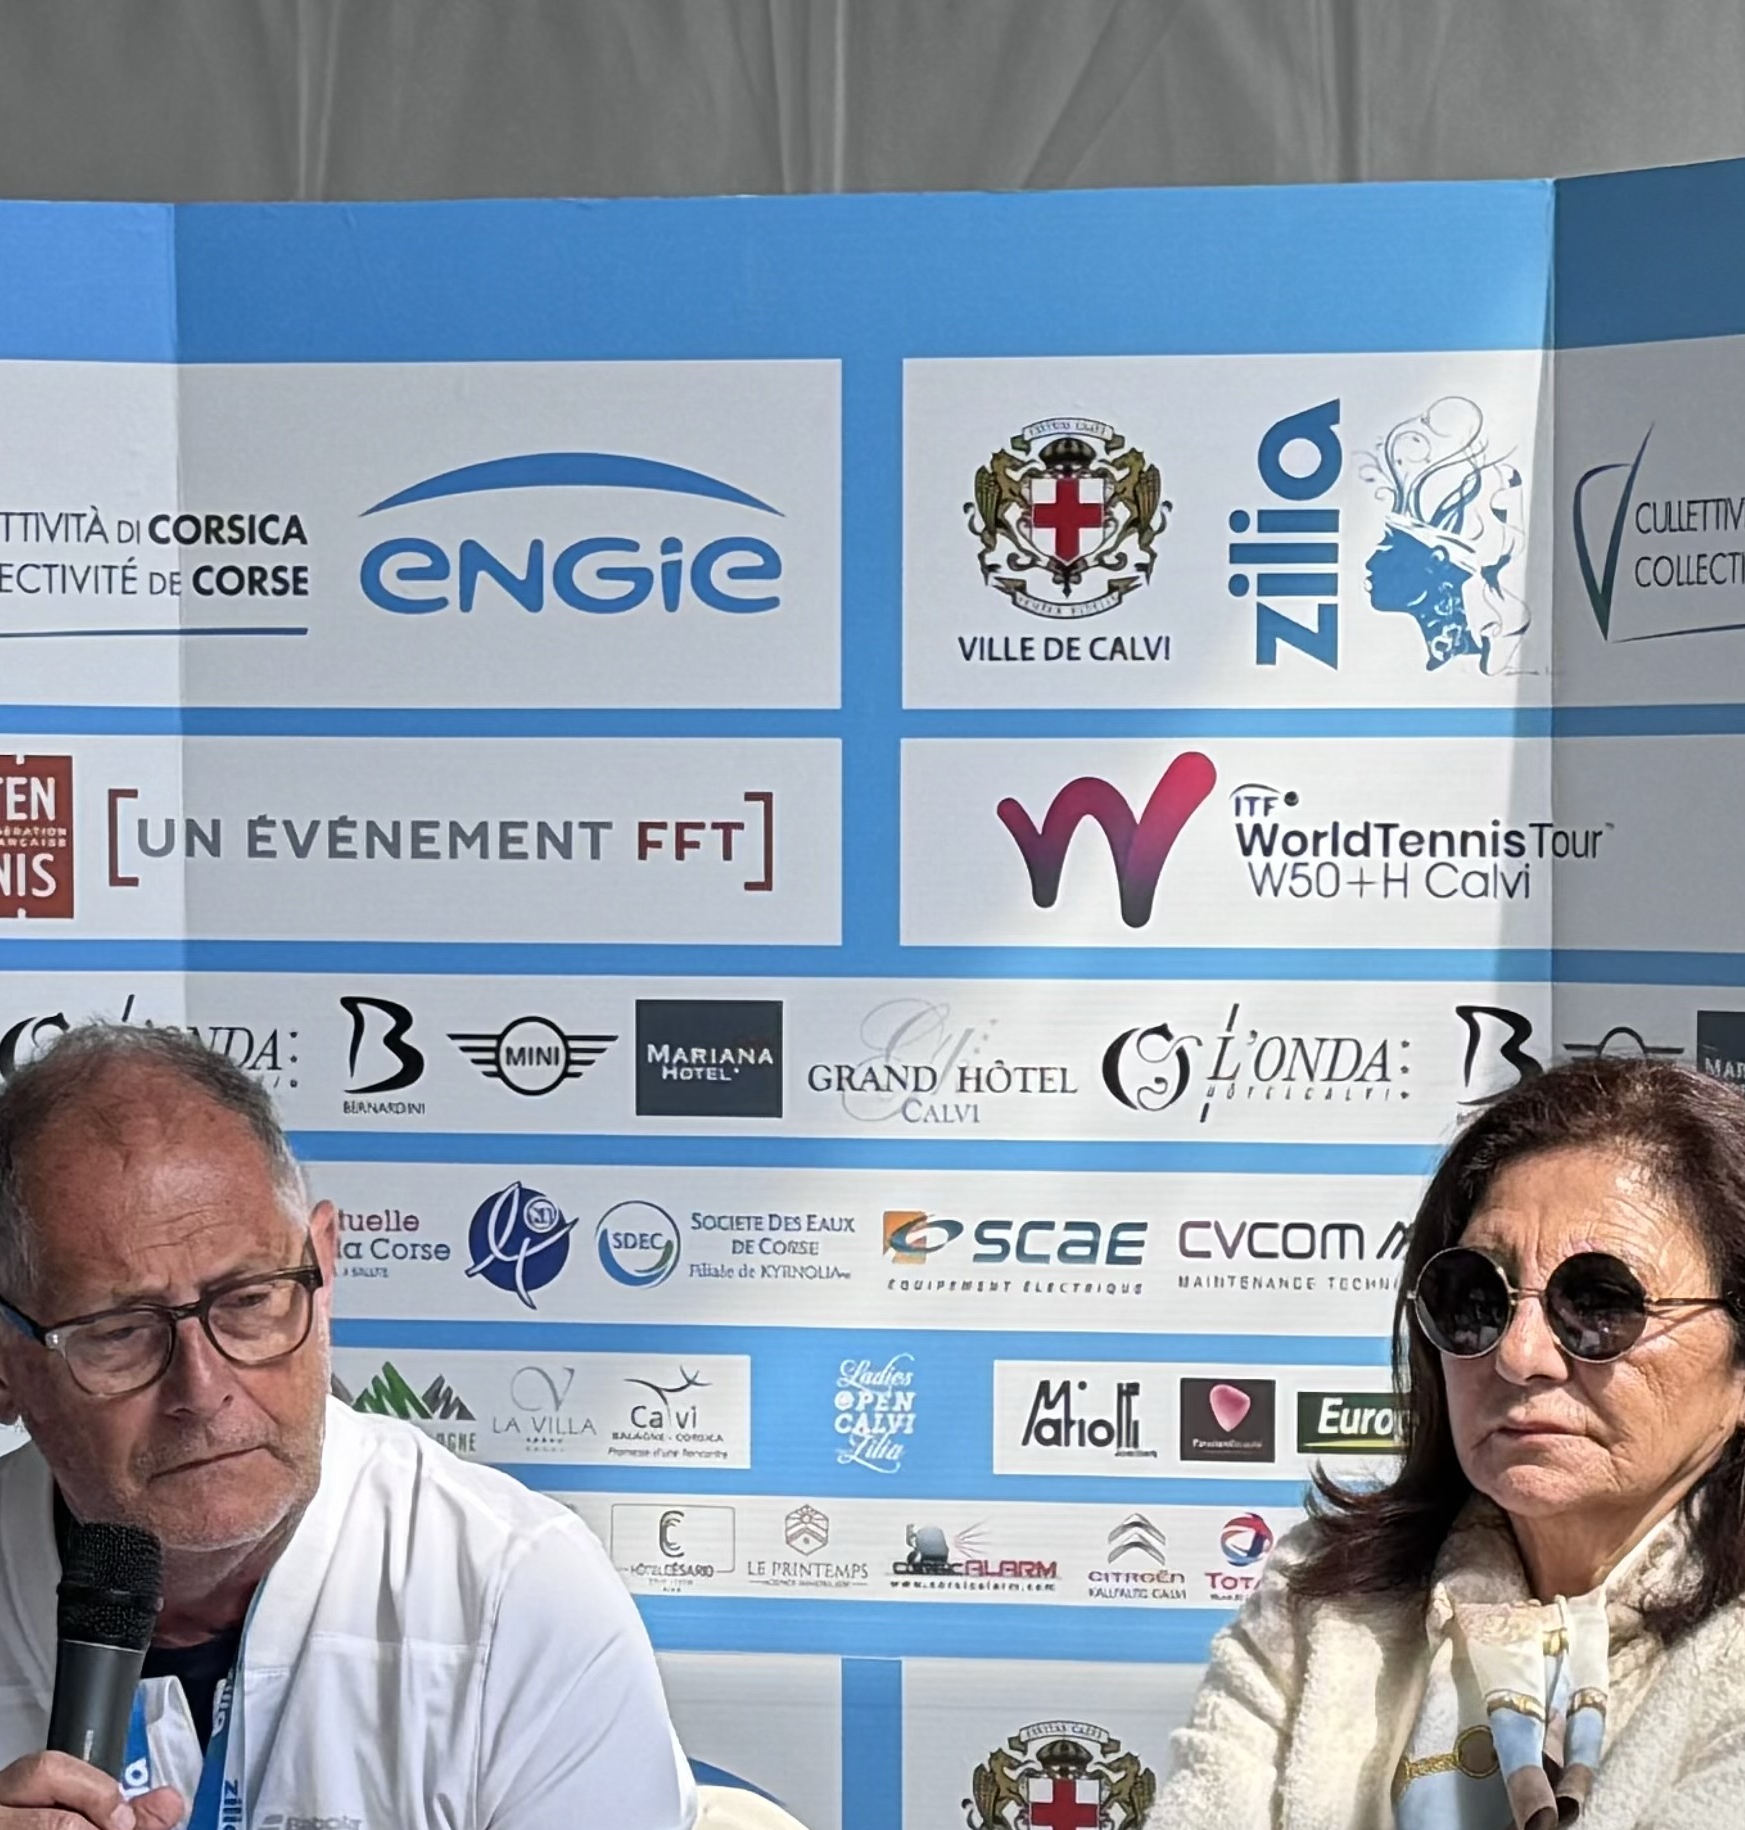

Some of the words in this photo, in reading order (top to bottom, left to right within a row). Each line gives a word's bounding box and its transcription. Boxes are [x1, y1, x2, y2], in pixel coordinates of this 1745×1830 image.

[116, 517, 142, 545] DI
[148, 511, 308, 546] CORSICA
[1227, 397, 1343, 671] zilia
[149, 569, 182, 598] DE
[192, 563, 310, 598] CORSE
[957, 635, 1036, 662] VILLE
[1044, 636, 1082, 661] DE
[1089, 635, 1172, 662] CALVI
[1234, 795, 1279, 818] ITF
[252, 813, 614, 862] ÉVÉNEMENT
[636, 820, 748, 863] FFT
[1248, 861, 1409, 900] W50+H
[1424, 861, 1531, 900] Calvi
[504, 1045, 560, 1068] MINI
[647, 1044, 774, 1066] MARIANA
[661, 1066, 732, 1083] HOTEL
[807, 1063, 938, 1094] GRAND
[957, 1058, 1079, 1095] HÔTEL
[901, 1099, 981, 1124] CALVI
[338, 1208, 420, 1232] tuelle
[370, 1237, 452, 1262] Corse
[612, 1231, 664, 1251] SDEC
[732, 1239, 755, 1256] DE
[1178, 1219, 1366, 1261] CVCOM
[1178, 1274, 1317, 1292] MAINTENANCE
[836, 1353, 916, 1392] Ladies
[834, 1390, 917, 1412] OPEN
[492, 1416, 521, 1434] LA
[531, 1415, 597, 1436] VILLA
[834, 1412, 917, 1435] CALVI
[747, 1560, 766, 1577] LE
[771, 1560, 869, 1579] PRINTEMPS
